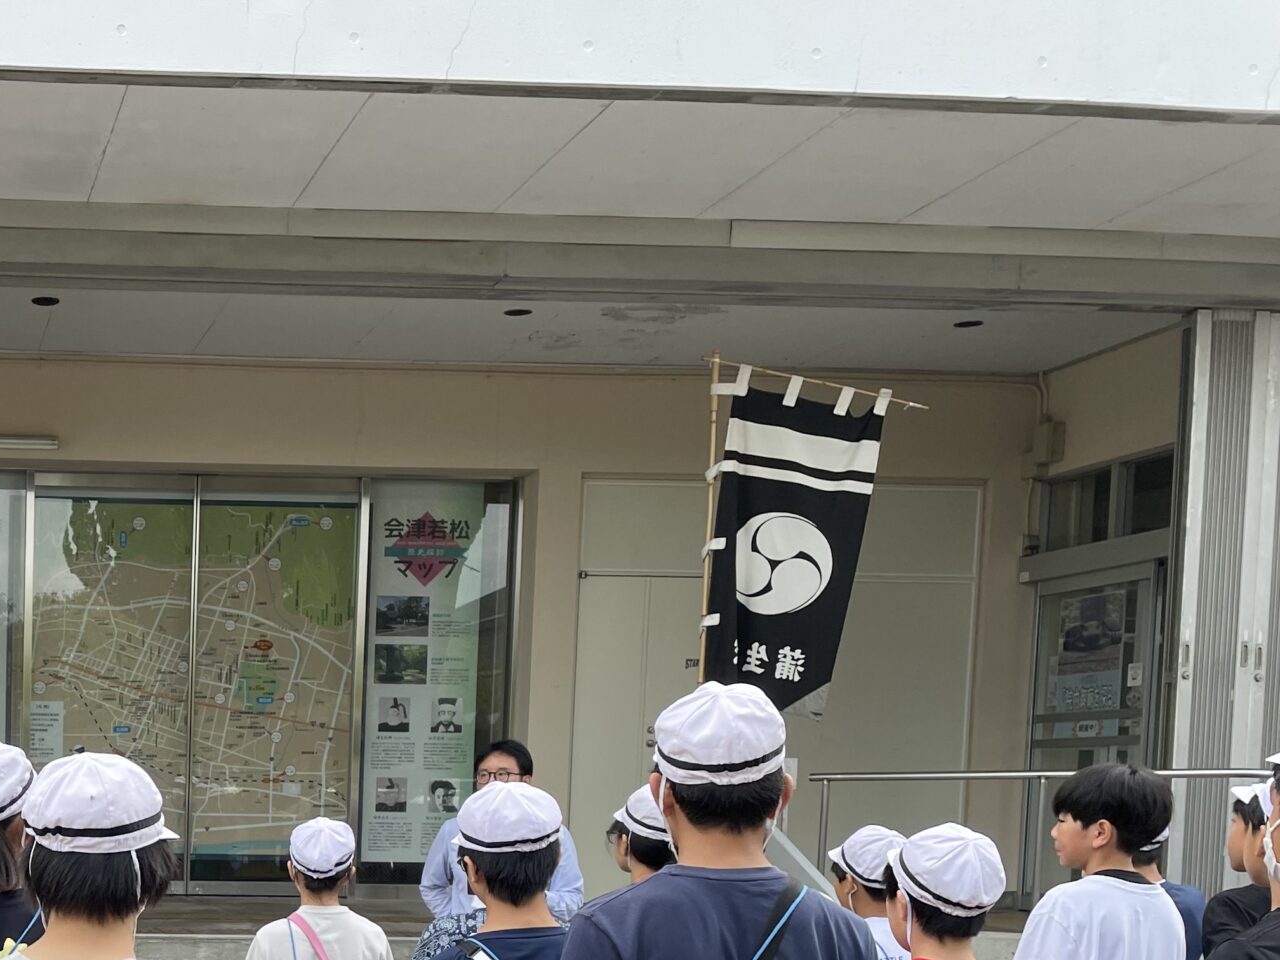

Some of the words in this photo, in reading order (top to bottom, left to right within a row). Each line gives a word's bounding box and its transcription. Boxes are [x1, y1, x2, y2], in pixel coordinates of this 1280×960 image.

[384, 518, 470, 539] 会津若松
[394, 558, 458, 578] マップ
